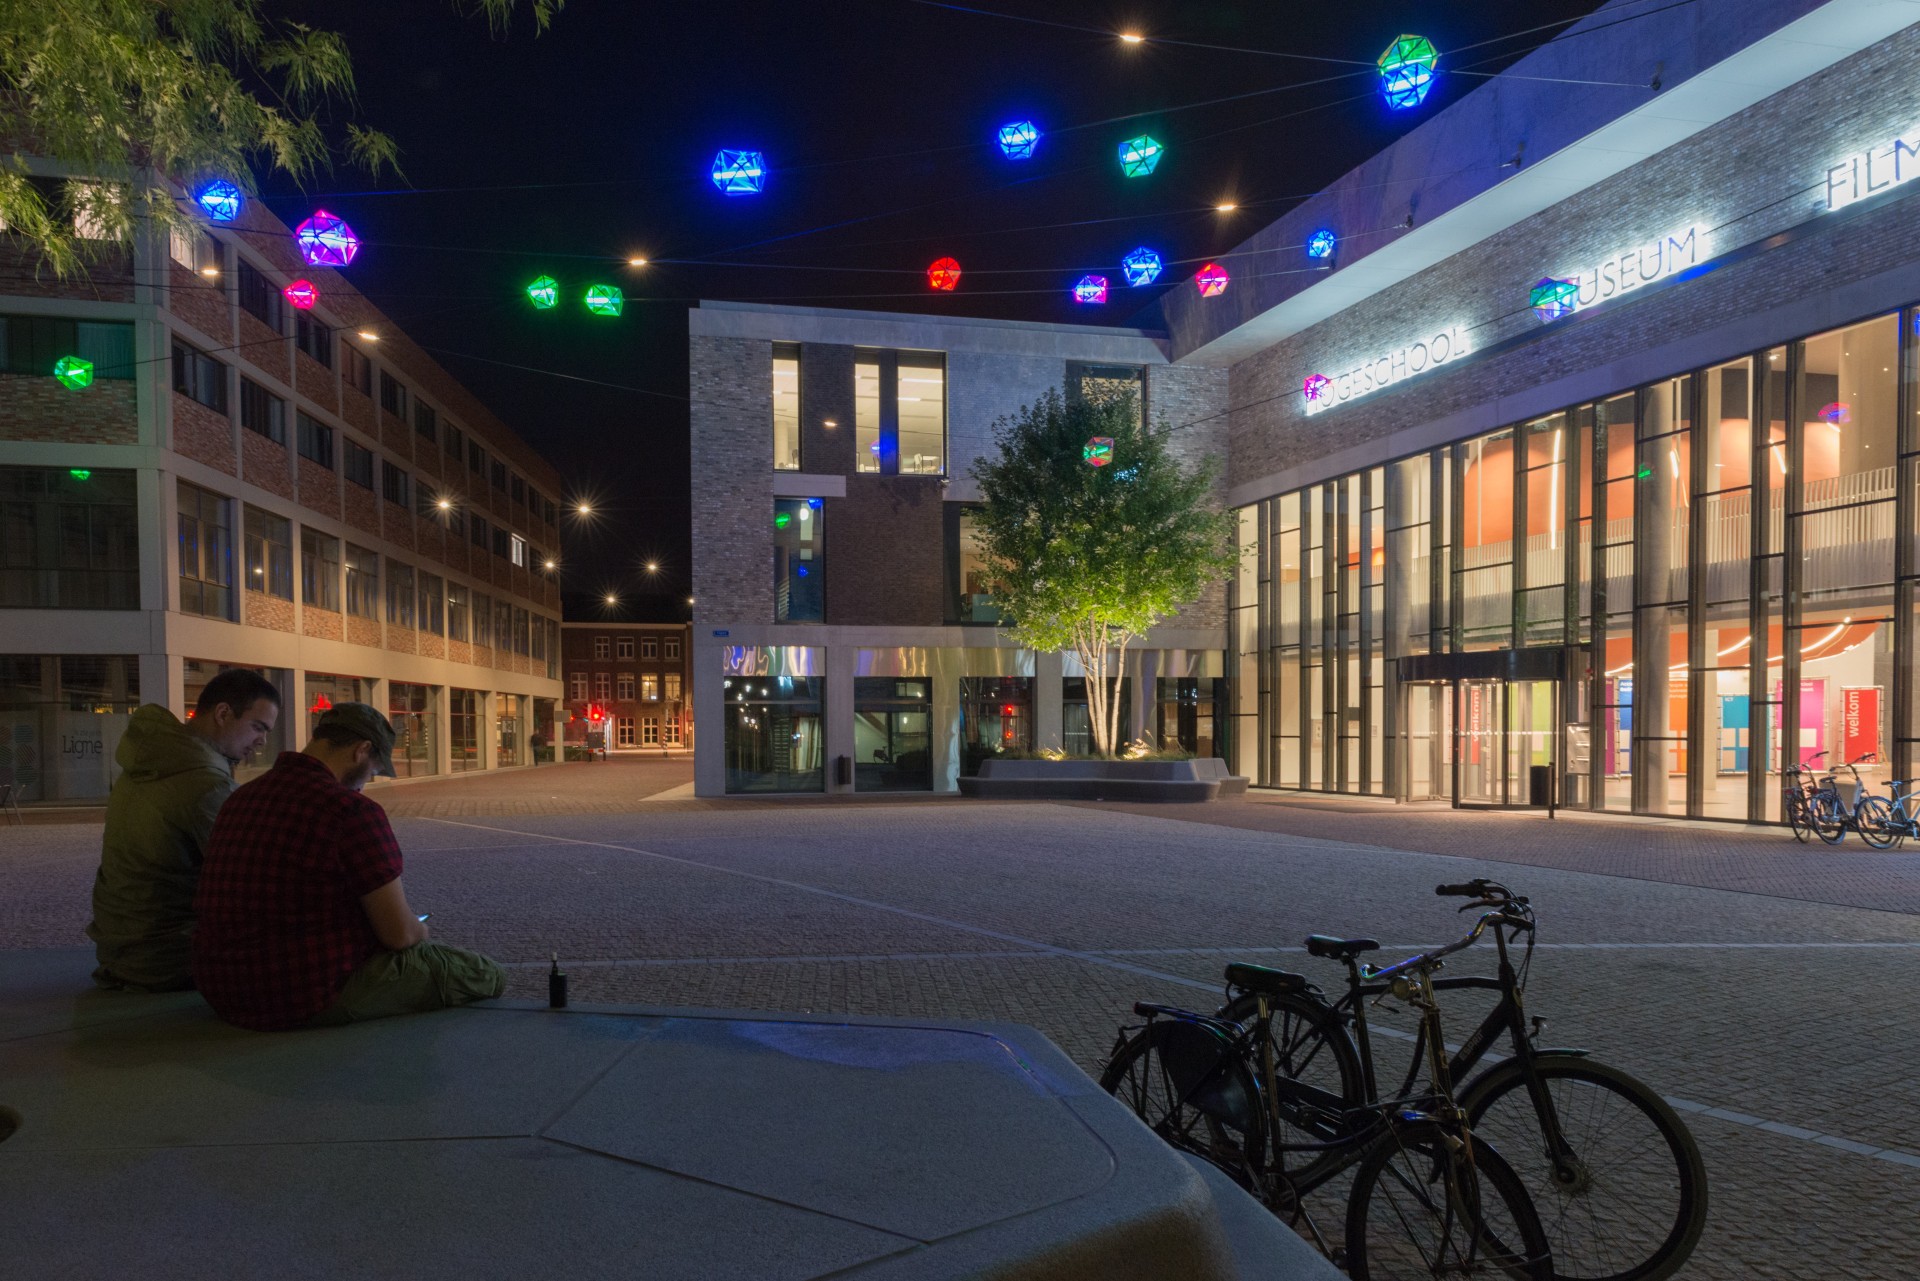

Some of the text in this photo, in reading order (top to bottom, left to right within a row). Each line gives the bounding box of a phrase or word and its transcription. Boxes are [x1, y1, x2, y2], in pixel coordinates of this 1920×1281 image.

[1576, 227, 1696, 306] USEUM
[1826, 139, 1920, 210] FILM
[1846, 691, 1860, 738] welkom
[62, 735, 103, 759] Ligne
